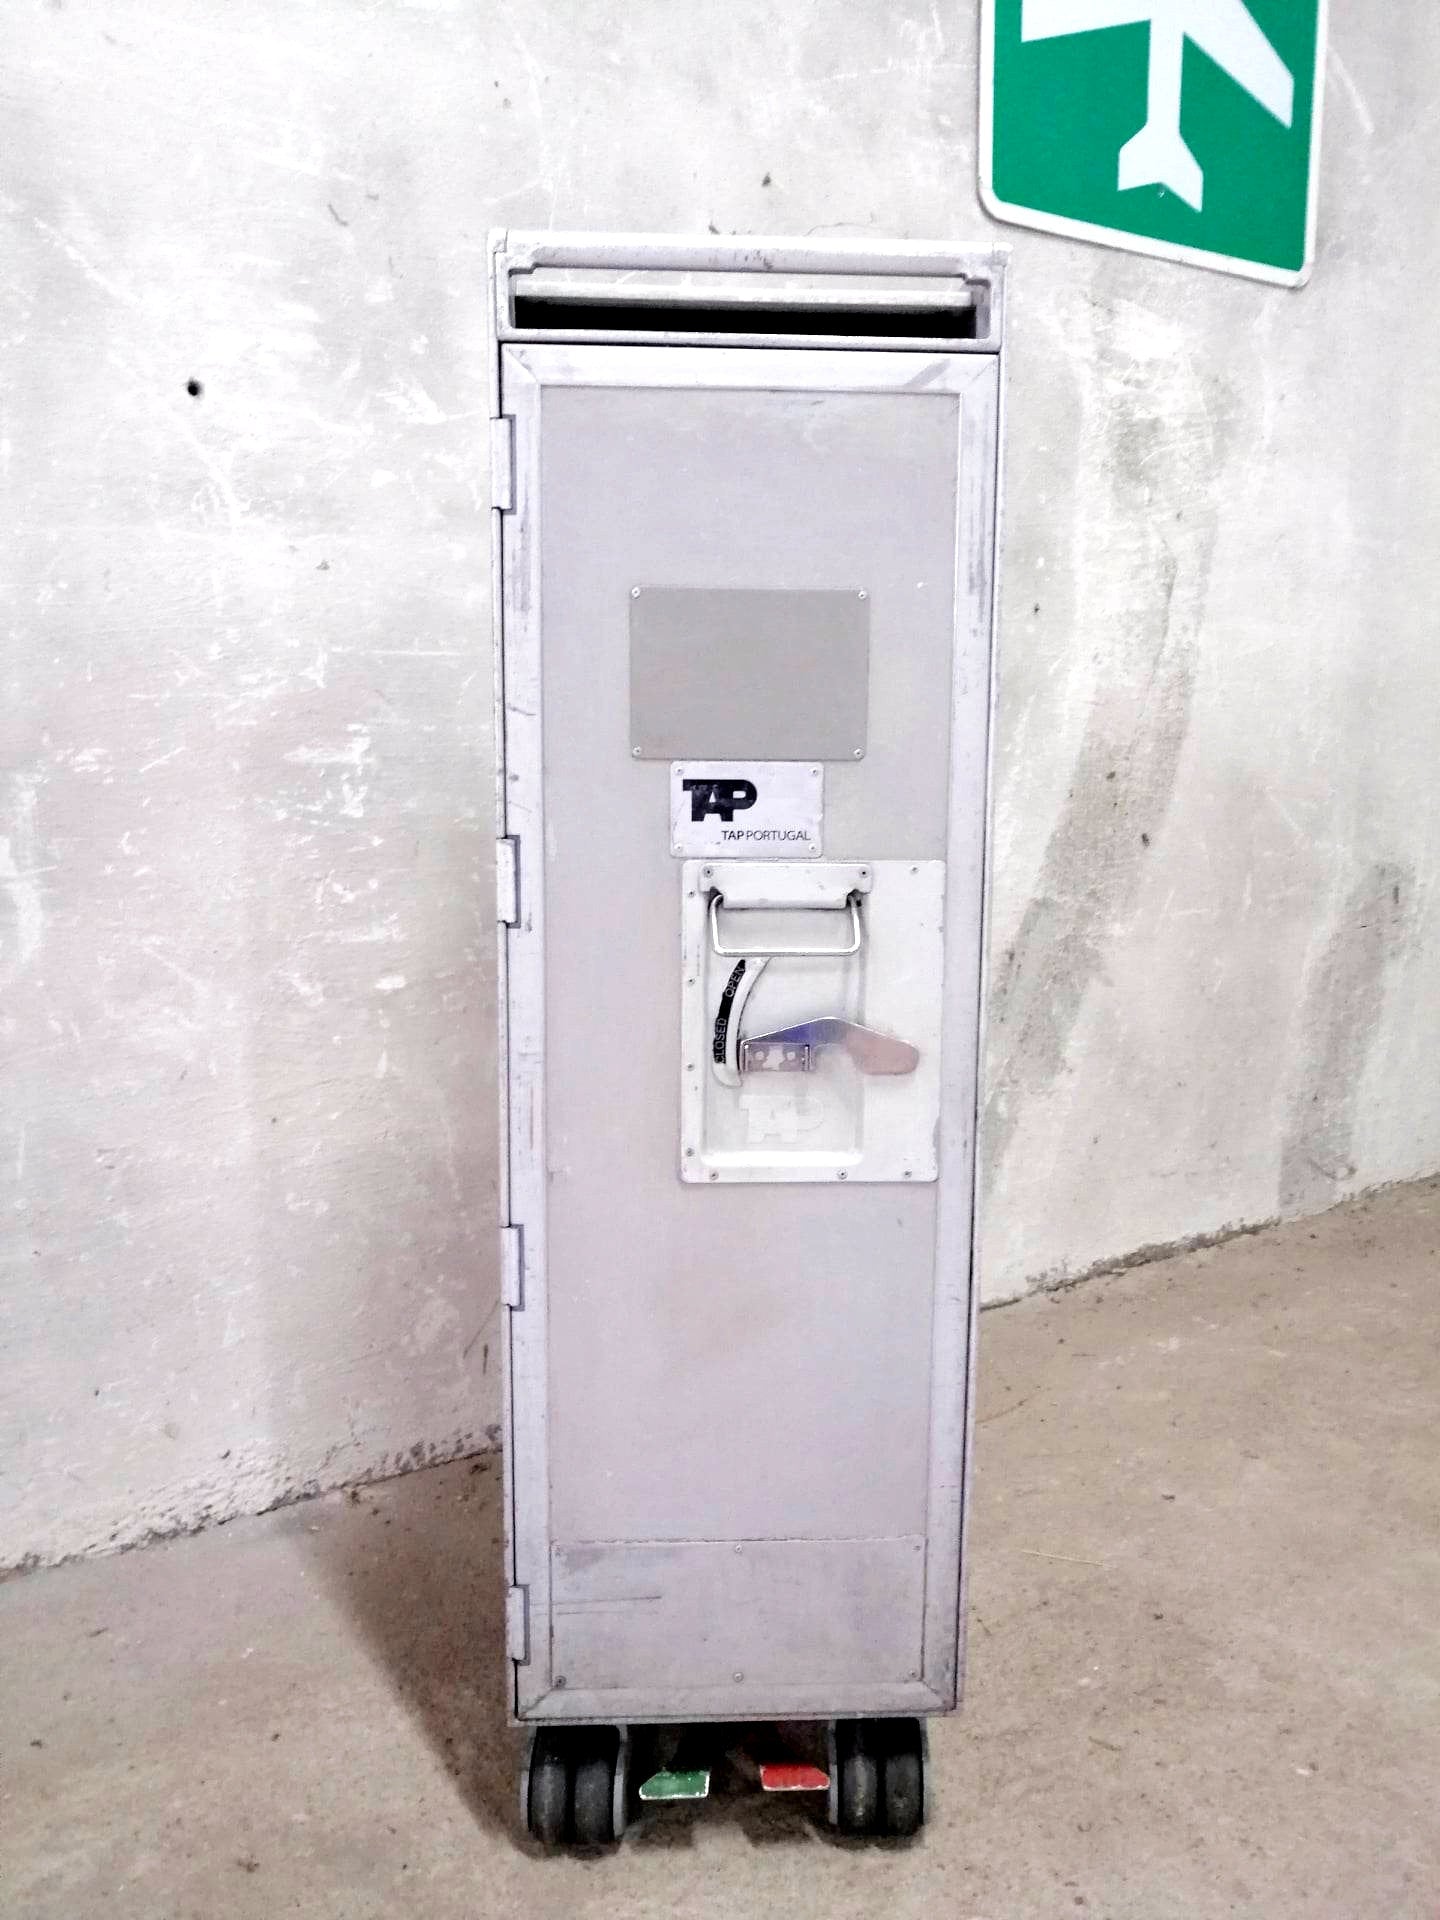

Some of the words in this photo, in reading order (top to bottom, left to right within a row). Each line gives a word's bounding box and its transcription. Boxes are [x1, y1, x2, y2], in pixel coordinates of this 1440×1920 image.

[683, 779, 757, 822] TAP
[721, 830, 744, 841] TAP
[746, 830, 811, 841] PORTUGAL
[724, 965, 745, 998] OPEN
[714, 1017, 727, 1064] CLOSED
